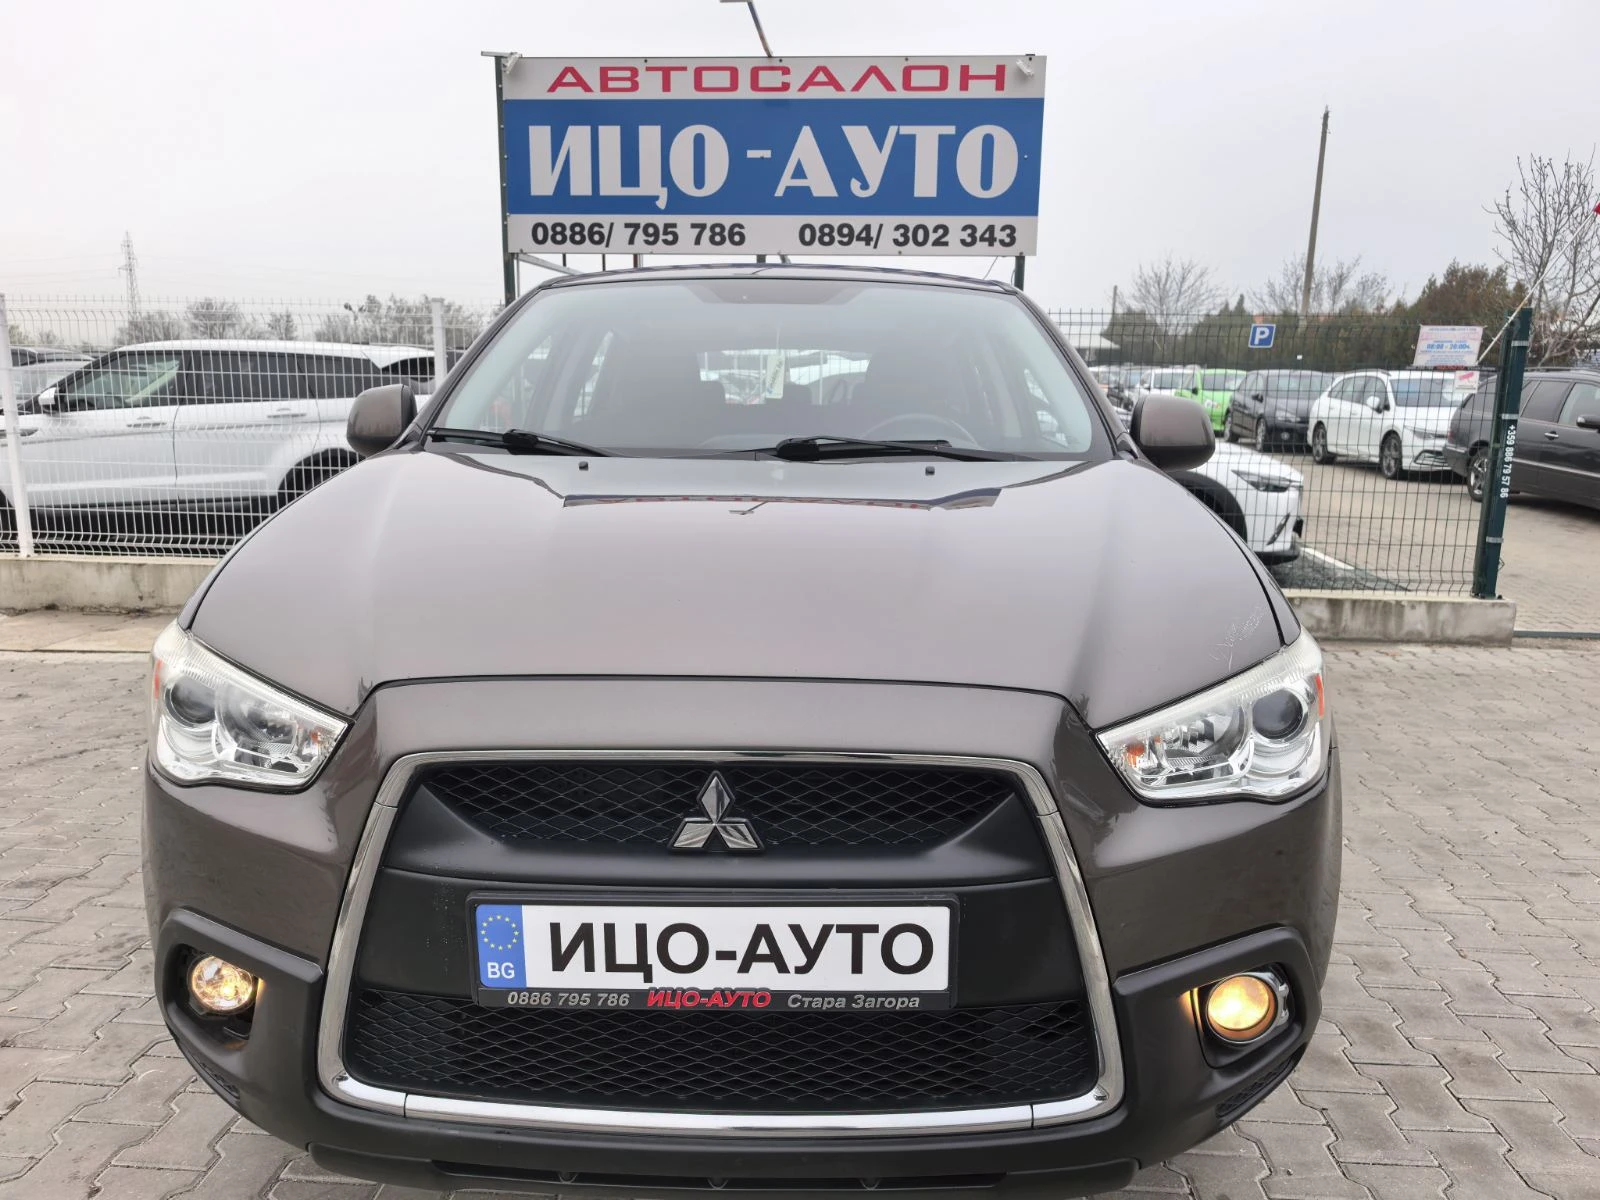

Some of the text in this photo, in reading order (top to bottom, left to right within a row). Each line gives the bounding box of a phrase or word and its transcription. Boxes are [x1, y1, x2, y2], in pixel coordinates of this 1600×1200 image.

[548, 65, 1007, 93] АВТОСАЛОН
[531, 222, 746, 248] 0886/ 795 786
[798, 223, 1017, 249] 0894/ 302 343
[1254, 327, 1270, 345] P
[1500, 424, 1516, 498] +359 886 79 57 86
[549, 922, 934, 984] ИЦО-АУТО
[487, 961, 515, 979] BG
[507, 991, 630, 1007] 0886 795 786
[646, 990, 772, 1009] ИЦО-АУТО
[787, 993, 920, 1010] Стара Загора
